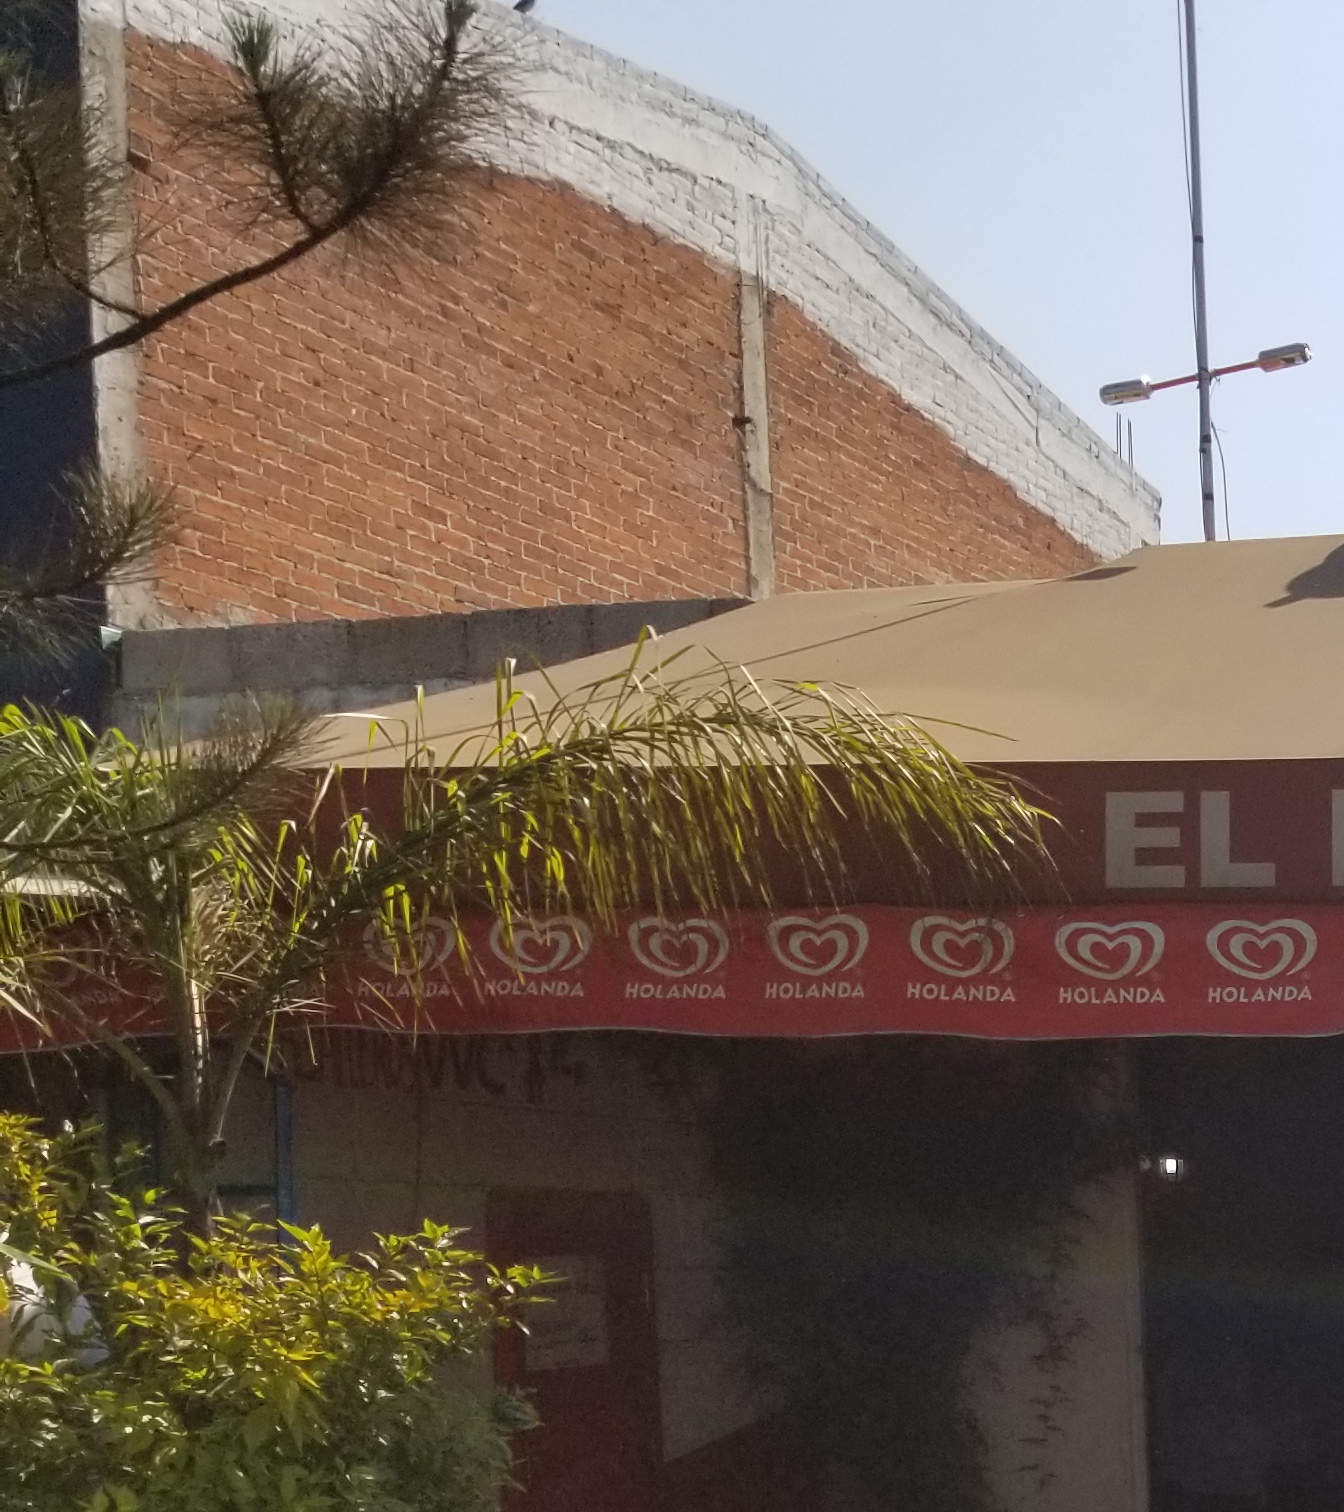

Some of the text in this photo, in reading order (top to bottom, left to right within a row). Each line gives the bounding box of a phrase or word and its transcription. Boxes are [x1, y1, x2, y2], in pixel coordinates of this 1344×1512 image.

[1104, 790, 1276, 890] EL
[484, 978, 585, 998] HOLANDA
[625, 981, 727, 999] HOLANDA
[765, 981, 866, 999] HOLANDA
[907, 982, 1017, 1002] HOLANDA
[1058, 986, 1166, 1005] HOLANDA
[1207, 984, 1313, 1004] HOLANDA
